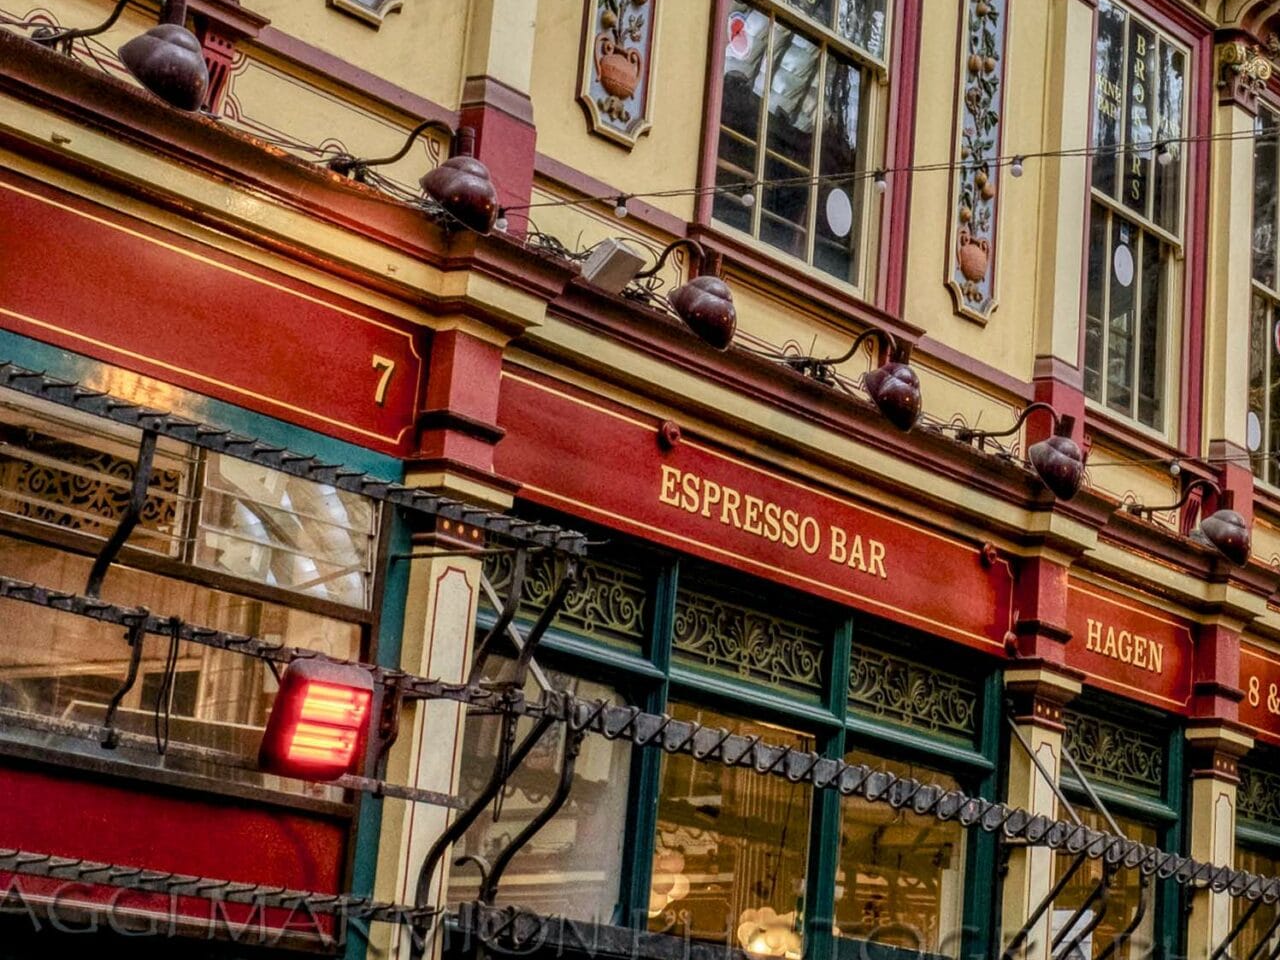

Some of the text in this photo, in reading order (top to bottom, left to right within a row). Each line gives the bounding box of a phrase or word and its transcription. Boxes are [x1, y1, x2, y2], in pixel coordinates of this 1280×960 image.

[371, 353, 396, 405] 7
[658, 464, 888, 579] ESPRESSO BAR
[1086, 618, 1164, 674] HAGEN
[1248, 675, 1260, 708] 8
